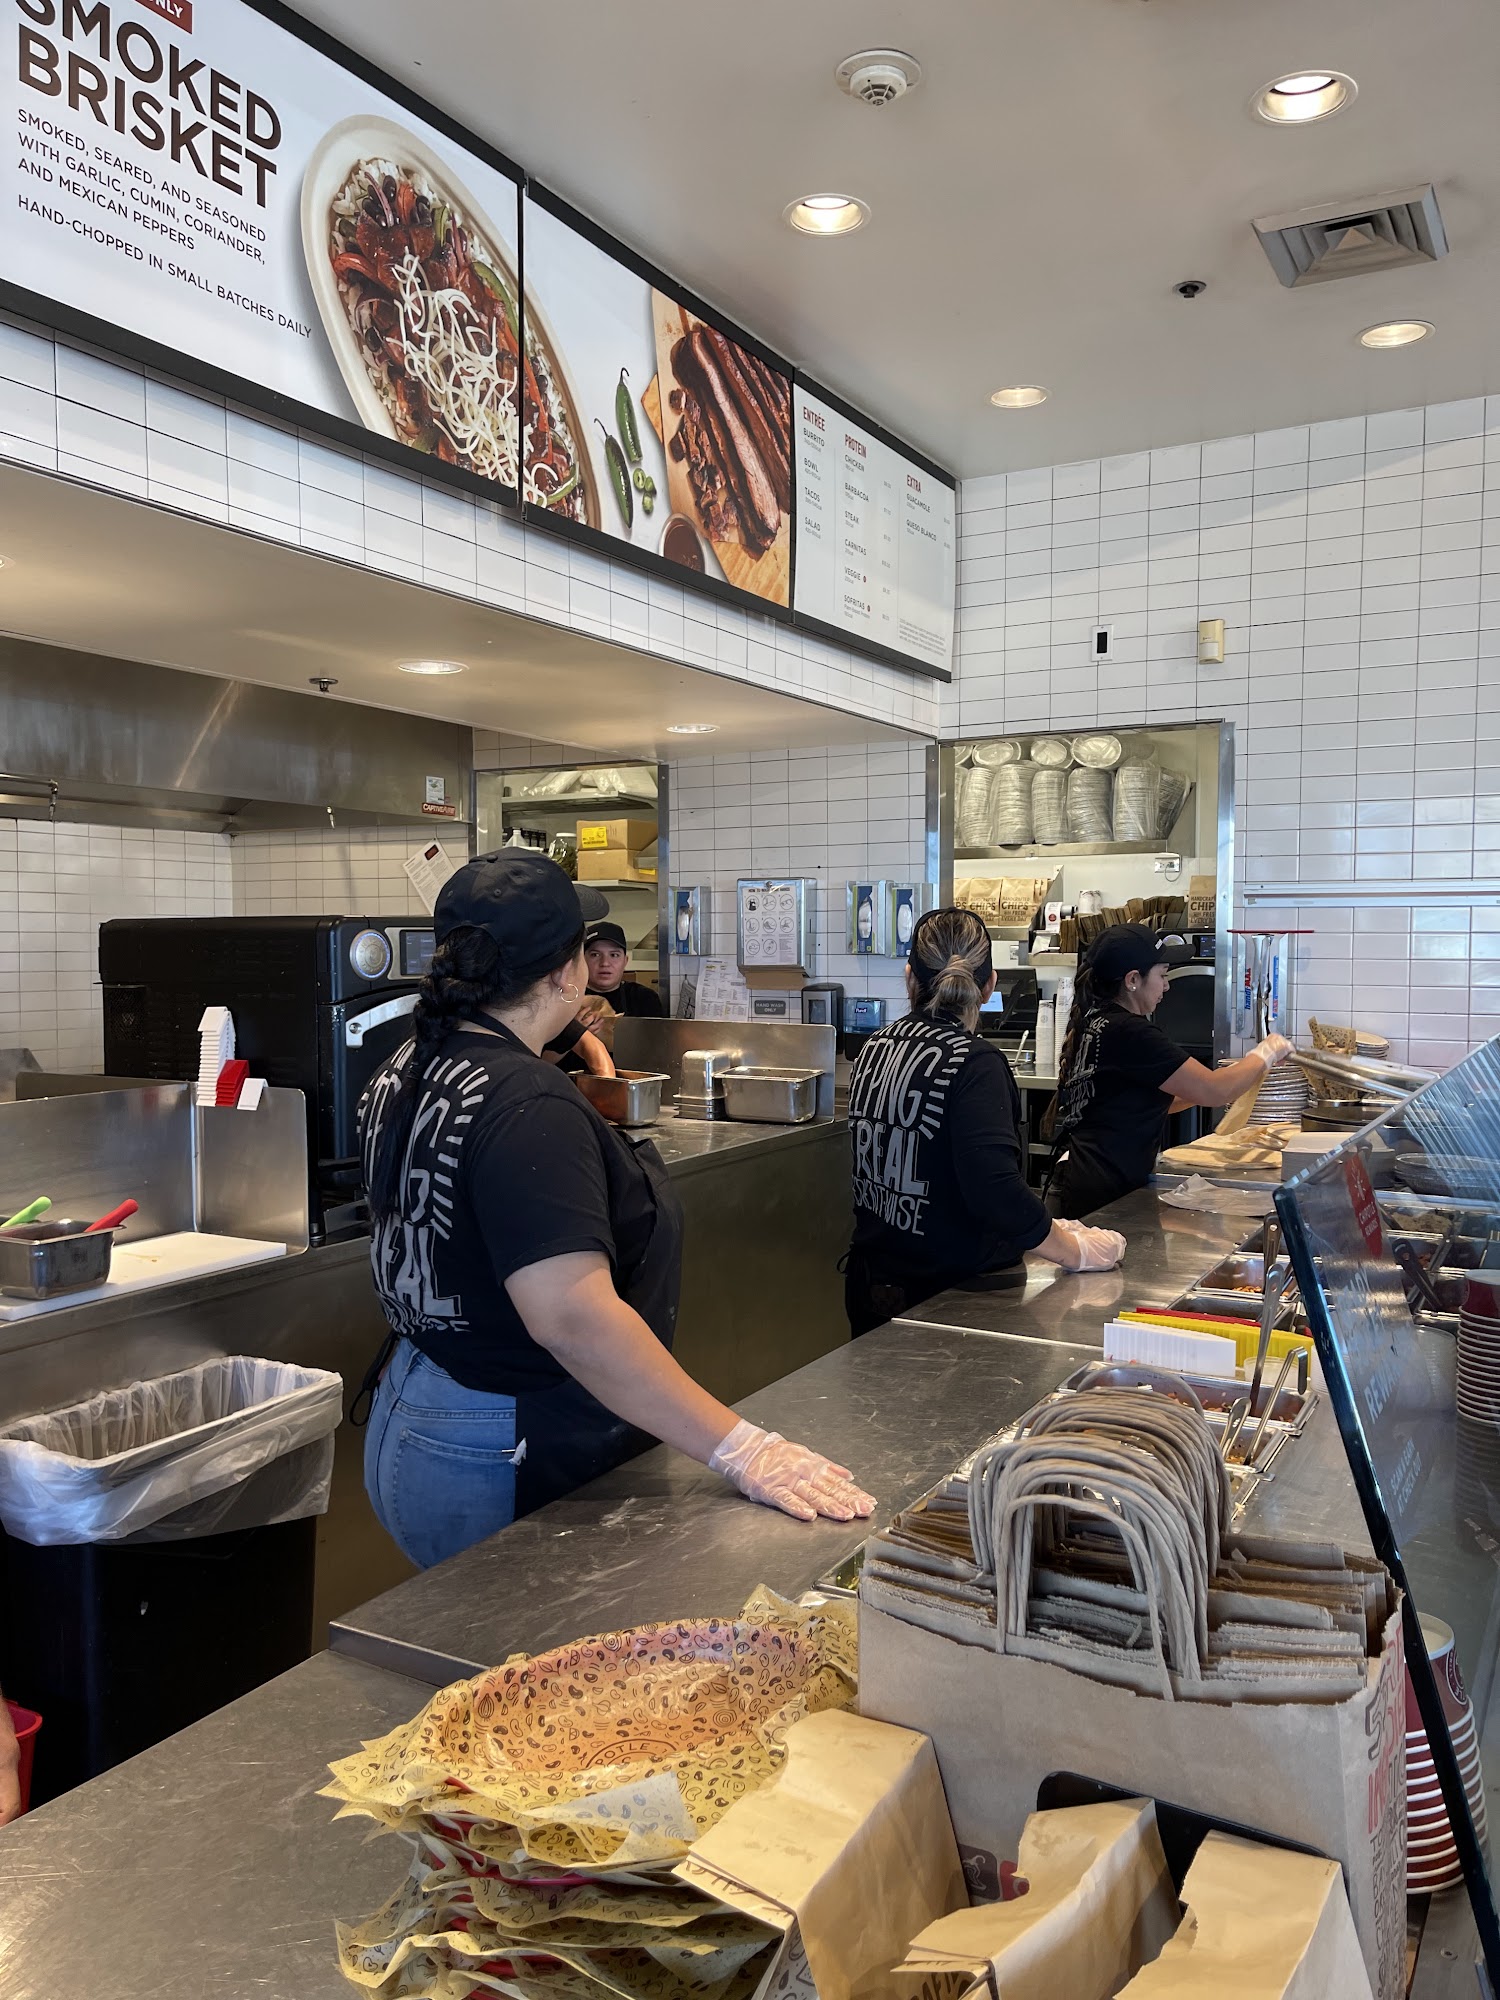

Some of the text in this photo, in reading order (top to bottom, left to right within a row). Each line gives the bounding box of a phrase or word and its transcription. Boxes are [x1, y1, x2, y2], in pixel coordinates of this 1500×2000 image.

[19, 23, 277, 208] BRISKET
[18, 109, 266, 242] SMOKED, SEARED, AND SEASONED
[18, 132, 266, 265] WITH GARLIC, CUMIN, CORIANDER,
[18, 158, 195, 250] AND MEXICAN PEPPERS
[18, 194, 311, 339] HAND-CHOPPED IN SMALL BATCHES DAILY
[803, 427, 825, 447] BURRITO
[844, 433, 867, 459] PROTEIN
[804, 457, 819, 473] BOWL
[844, 454, 865, 472] CHICKEN
[844, 482, 870, 502] BARBACOA
[906, 474, 922, 494] EXTRA
[804, 486, 820, 503] TACOS
[906, 493, 931, 513] GUACAMOLE
[804, 517, 821, 532] SALAD
[844, 510, 860, 524] STEAK
[906, 519, 920, 532] QUESO
[920, 527, 937, 541] BLANCO
[844, 538, 867, 556] CARNITAS
[844, 566, 861, 581] VEGGIE
[843, 594, 865, 610] SOFRITAS
[970, 902, 996, 911] CHIPS
[1001, 901, 1029, 910] CHIPS
[1190, 902, 1215, 911] CHIP
[848, 1038, 943, 1128] EEPING
[856, 1119, 930, 1197] REAL
[594, 1742, 651, 1766] POTLE
